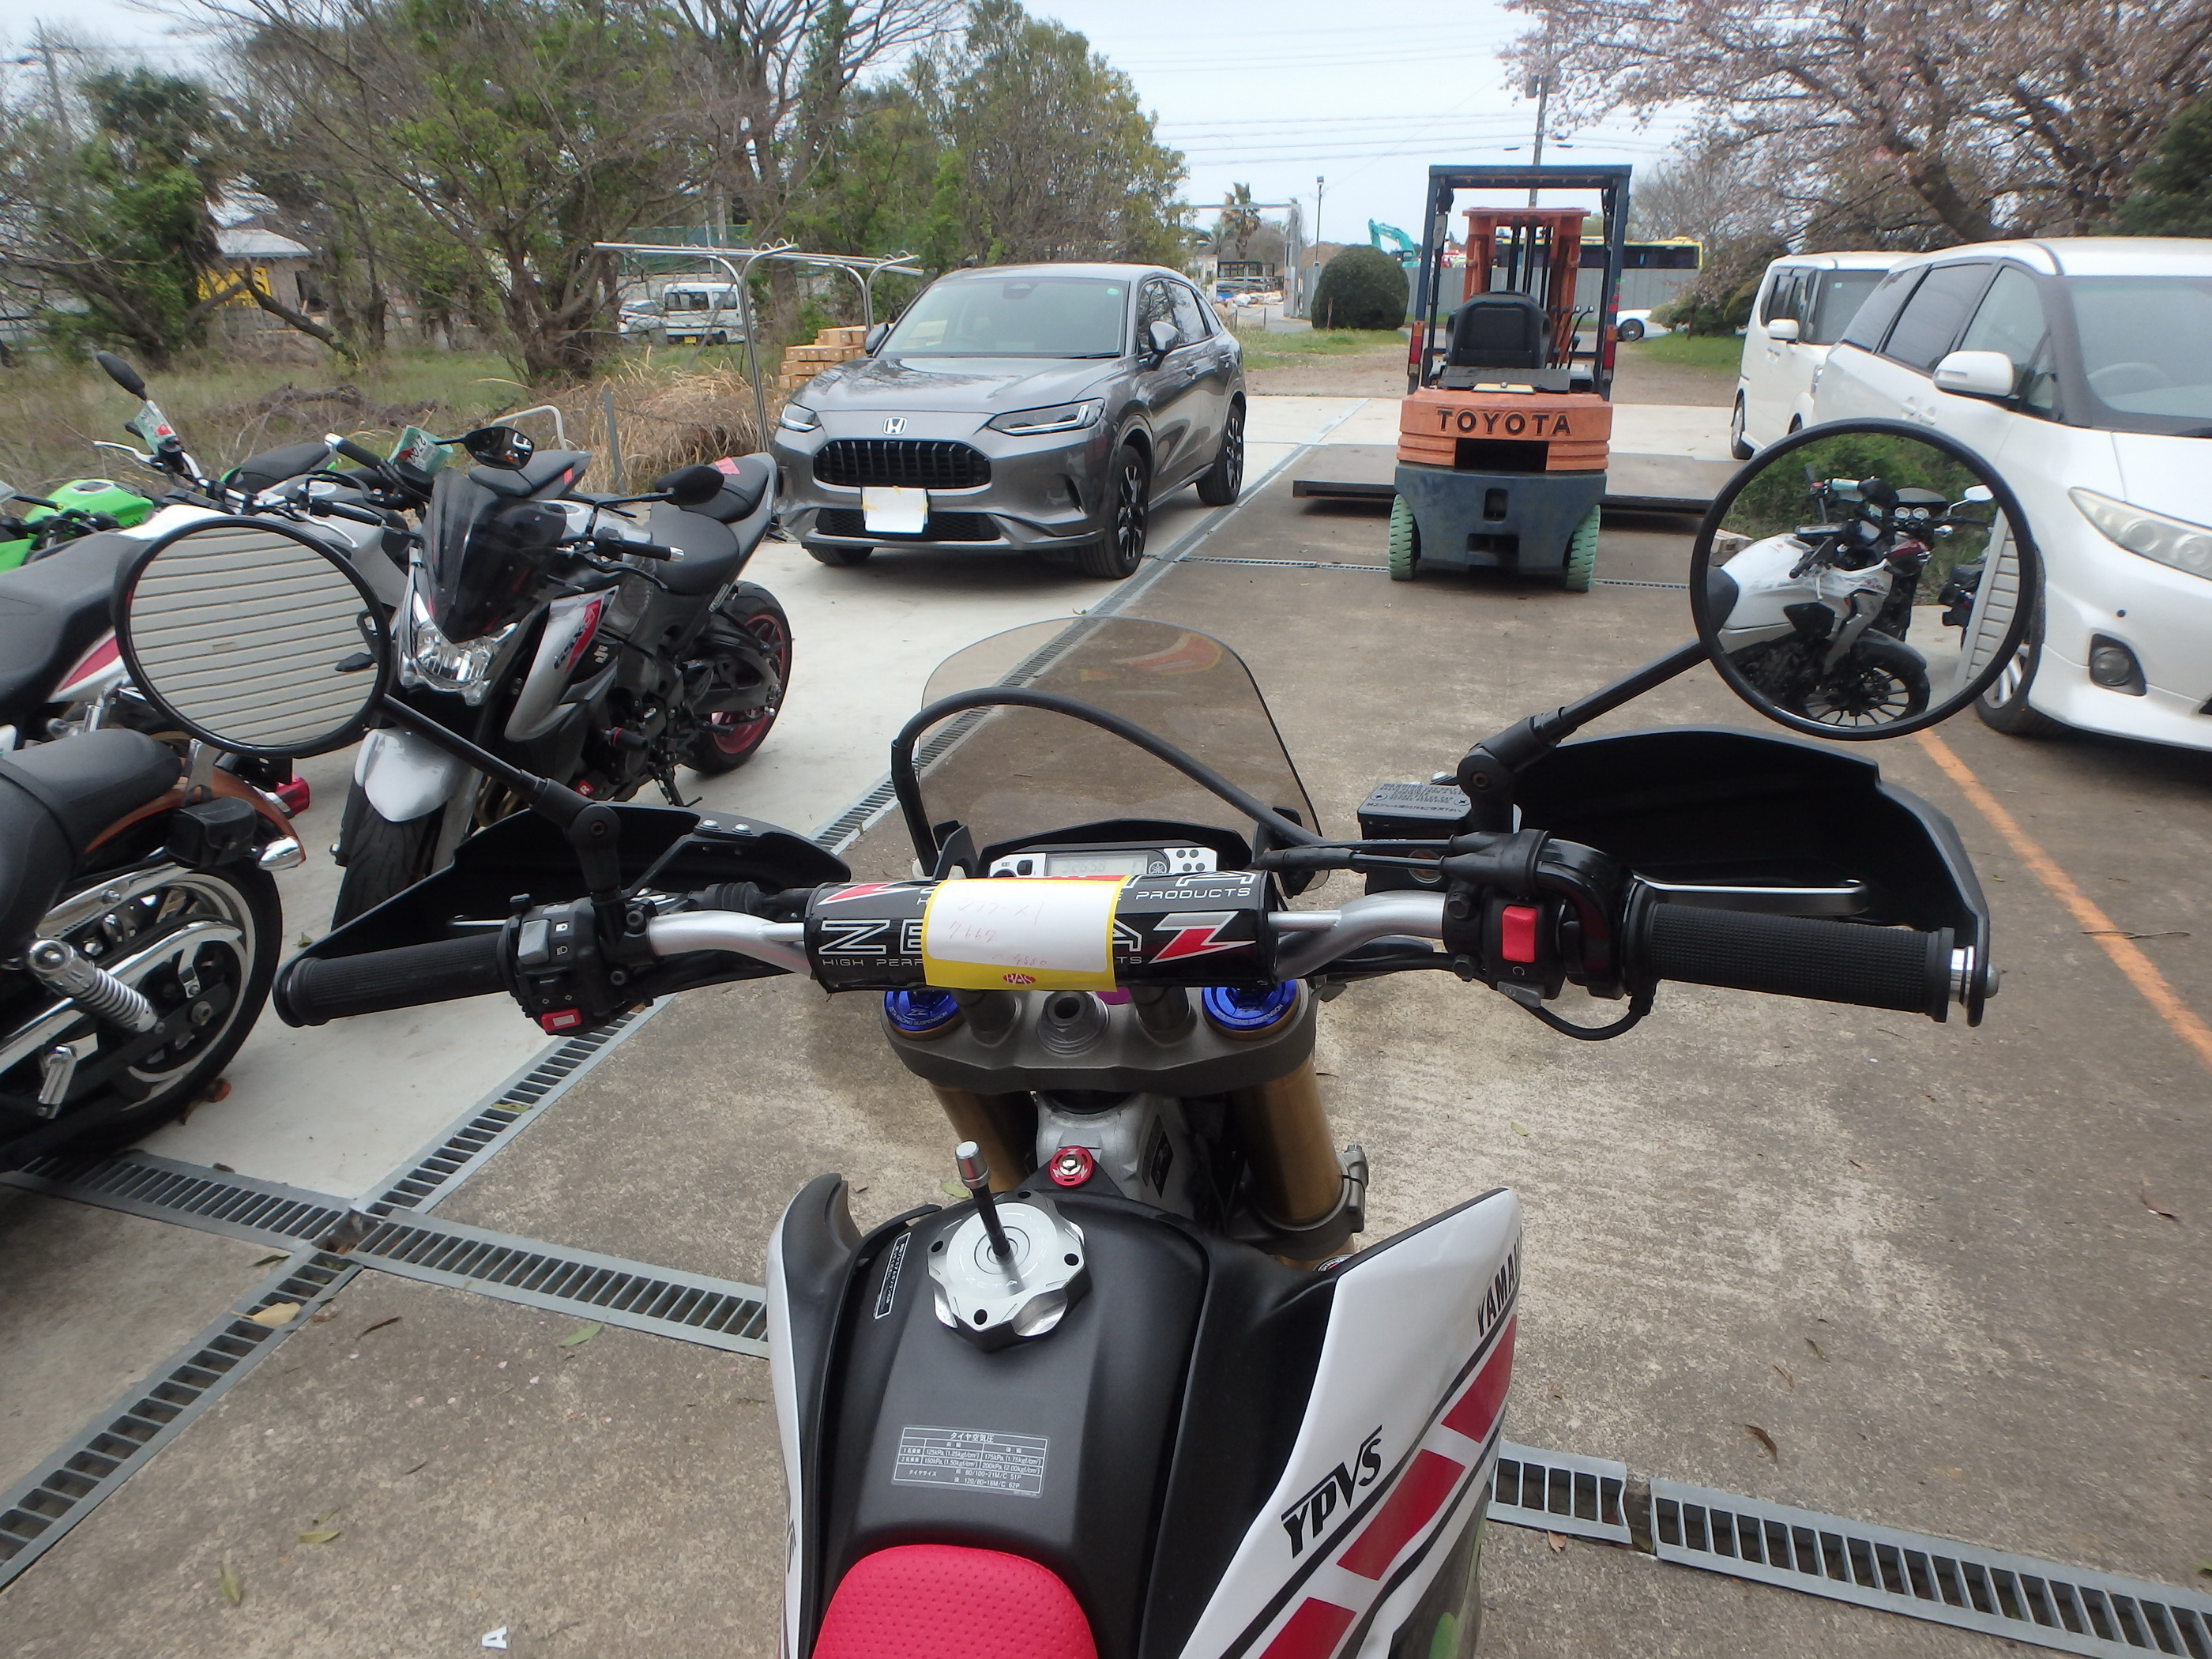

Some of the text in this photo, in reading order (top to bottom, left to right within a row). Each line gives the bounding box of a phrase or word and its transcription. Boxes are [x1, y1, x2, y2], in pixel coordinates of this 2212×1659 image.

[1437, 409, 1571, 435] TOYOTA
[1135, 887, 1251, 900] PRODUCTS
[1005, 973, 1033, 985] BAS
[913, 1010, 948, 1025] SUSPENSION
[965, 1274, 1018, 1289] ZETA
[950, 1432, 995, 1443] タイヤ空気圧
[1281, 1424, 1382, 1559] YPVS
